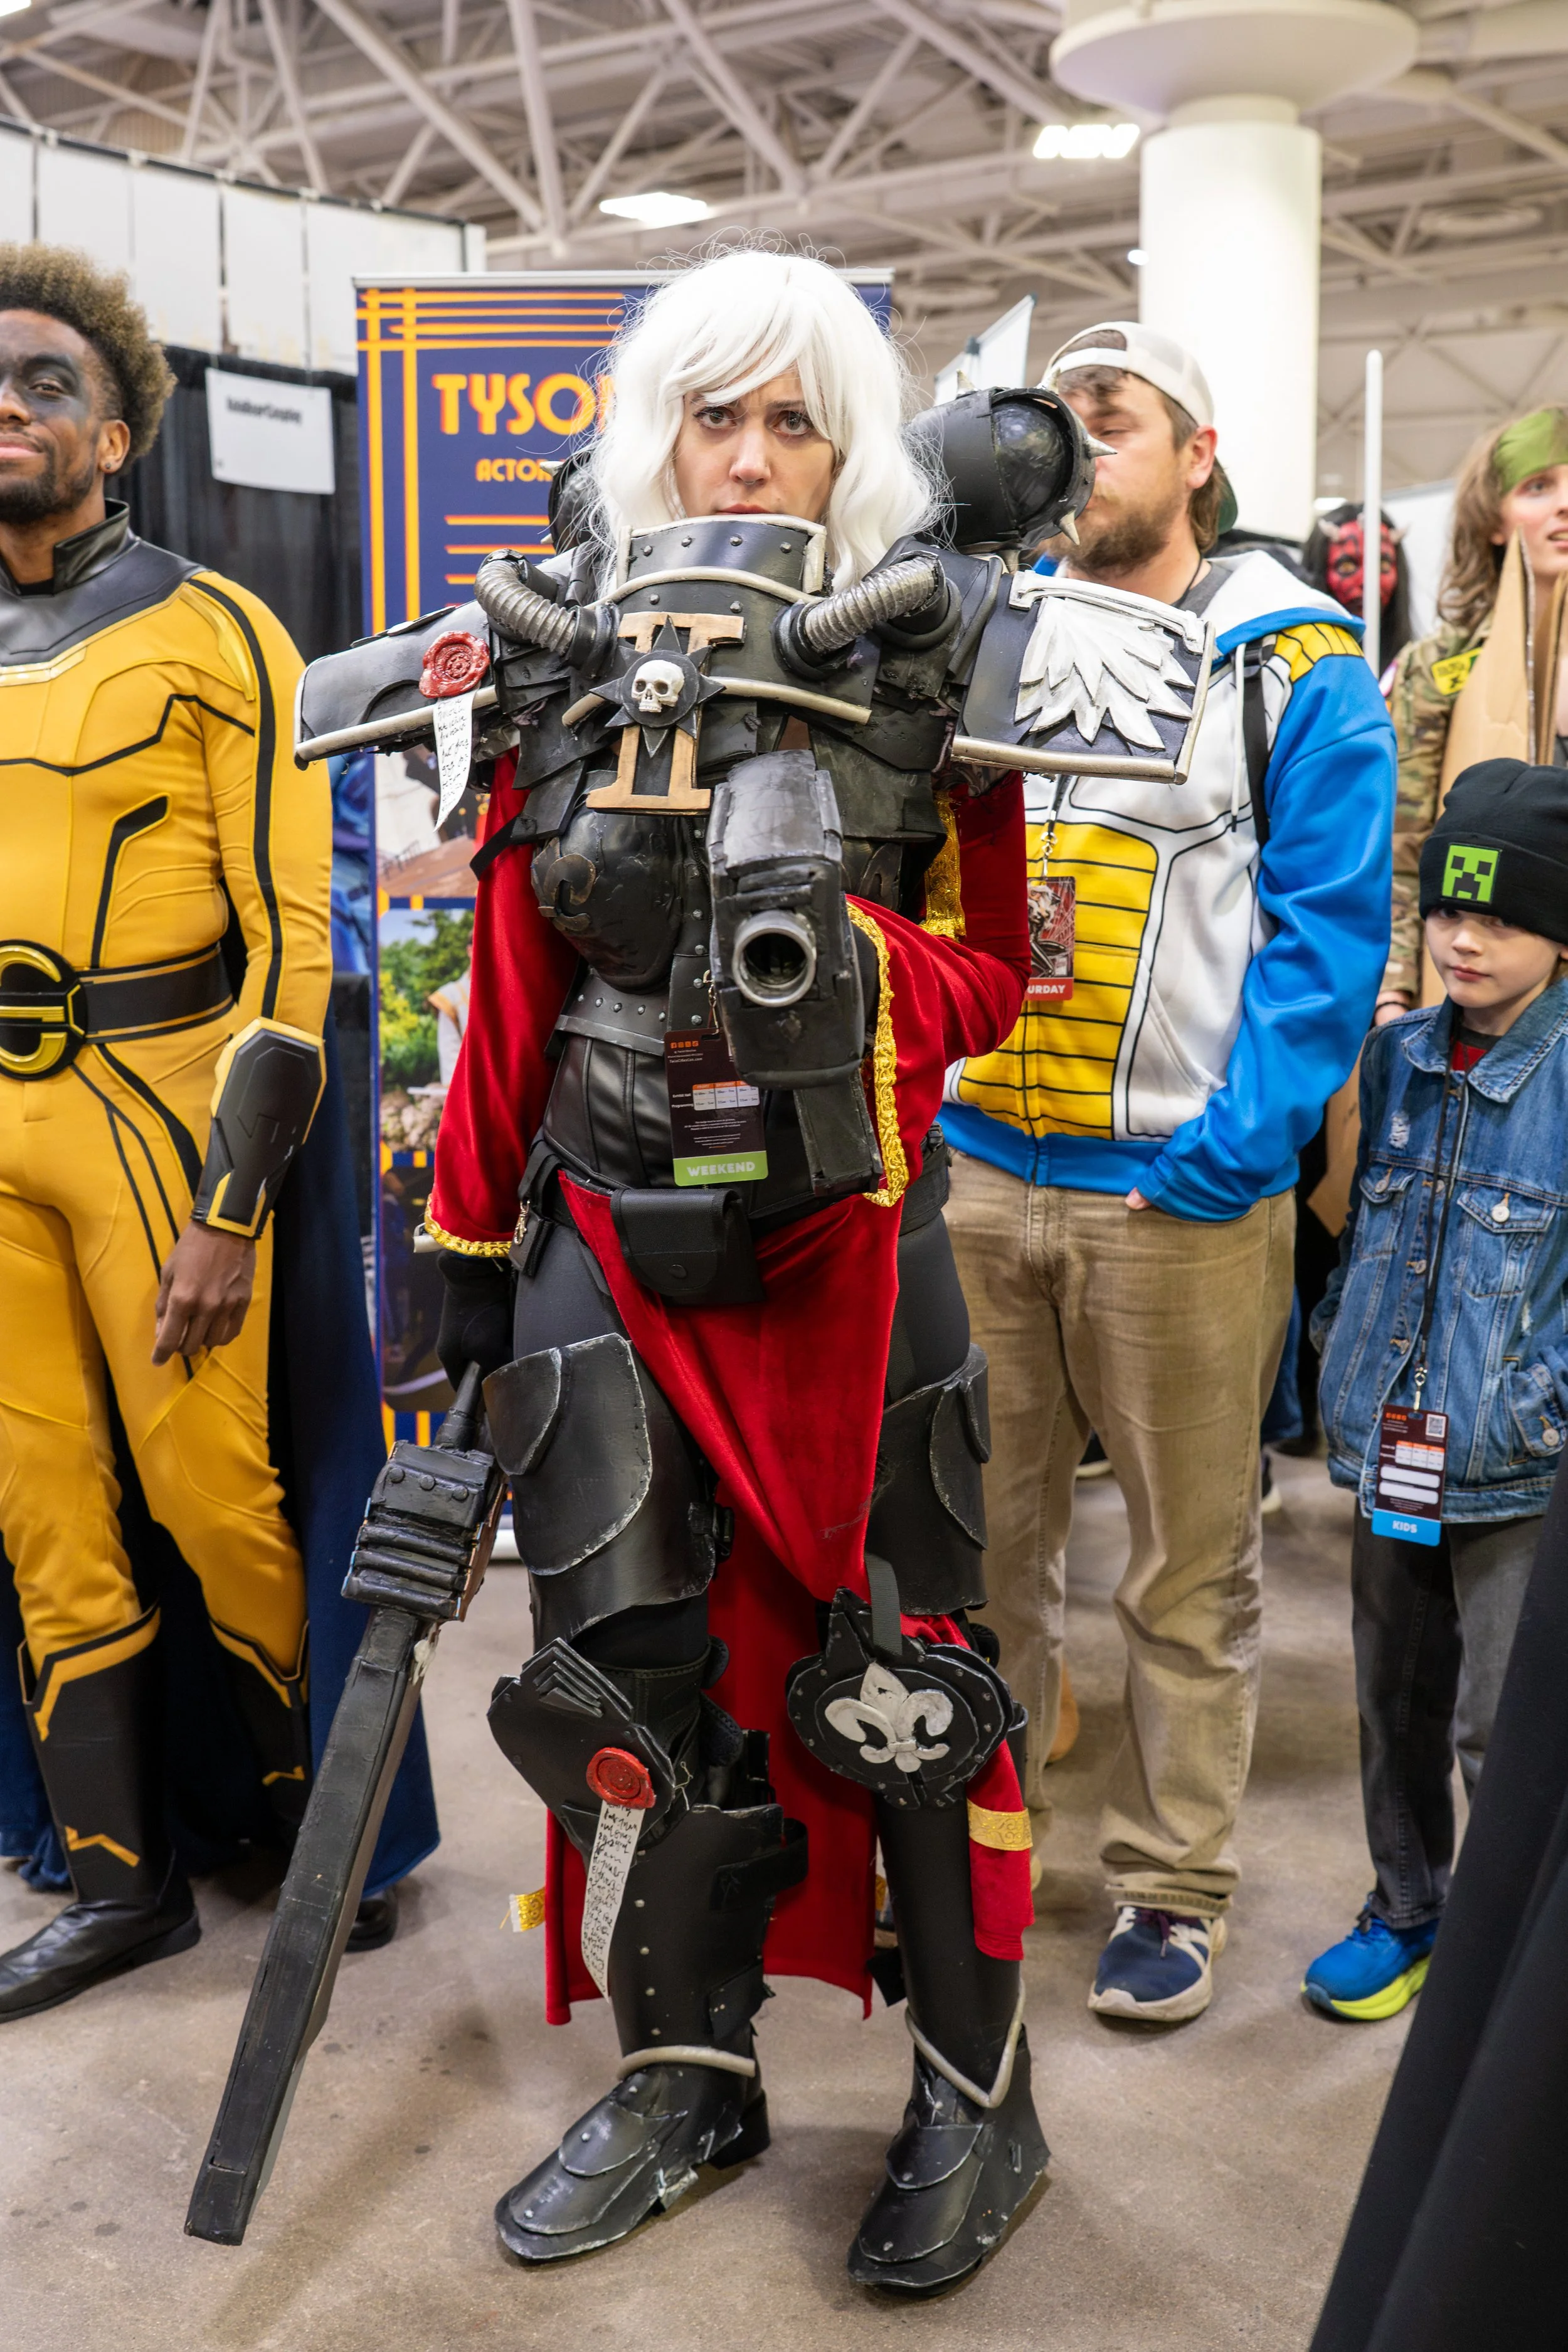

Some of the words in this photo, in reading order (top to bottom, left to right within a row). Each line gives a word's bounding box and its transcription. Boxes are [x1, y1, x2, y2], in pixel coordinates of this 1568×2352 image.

[1027, 985, 1066, 994] URDAY
[687, 1162, 755, 1177] WEEKEND
[1392, 1520, 1417, 1533] KIDS
